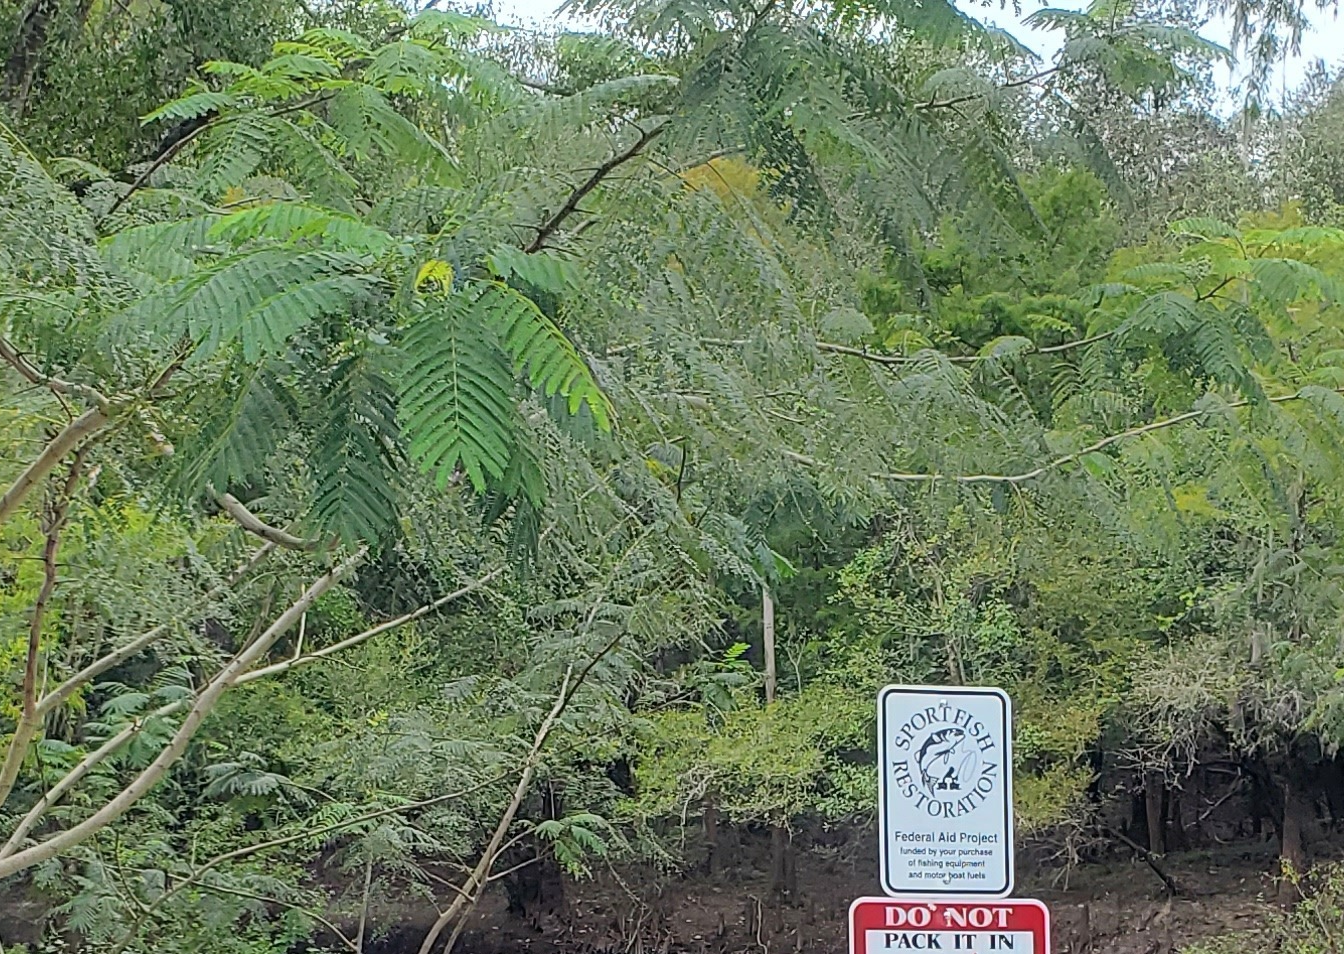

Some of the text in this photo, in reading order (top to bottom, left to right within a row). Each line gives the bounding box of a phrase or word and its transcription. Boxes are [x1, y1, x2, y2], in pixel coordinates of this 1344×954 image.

[892, 760, 998, 819] RESTORATION
[894, 831, 998, 845] Federal Aid Project
[900, 847, 993, 857] funded by your purchase
[908, 858, 985, 869] of fishing equipment
[908, 871, 922, 879] and
[948, 871, 965, 879] boat
[884, 906, 1013, 928] DO NOT
[884, 933, 1014, 950] PACK IT IN
